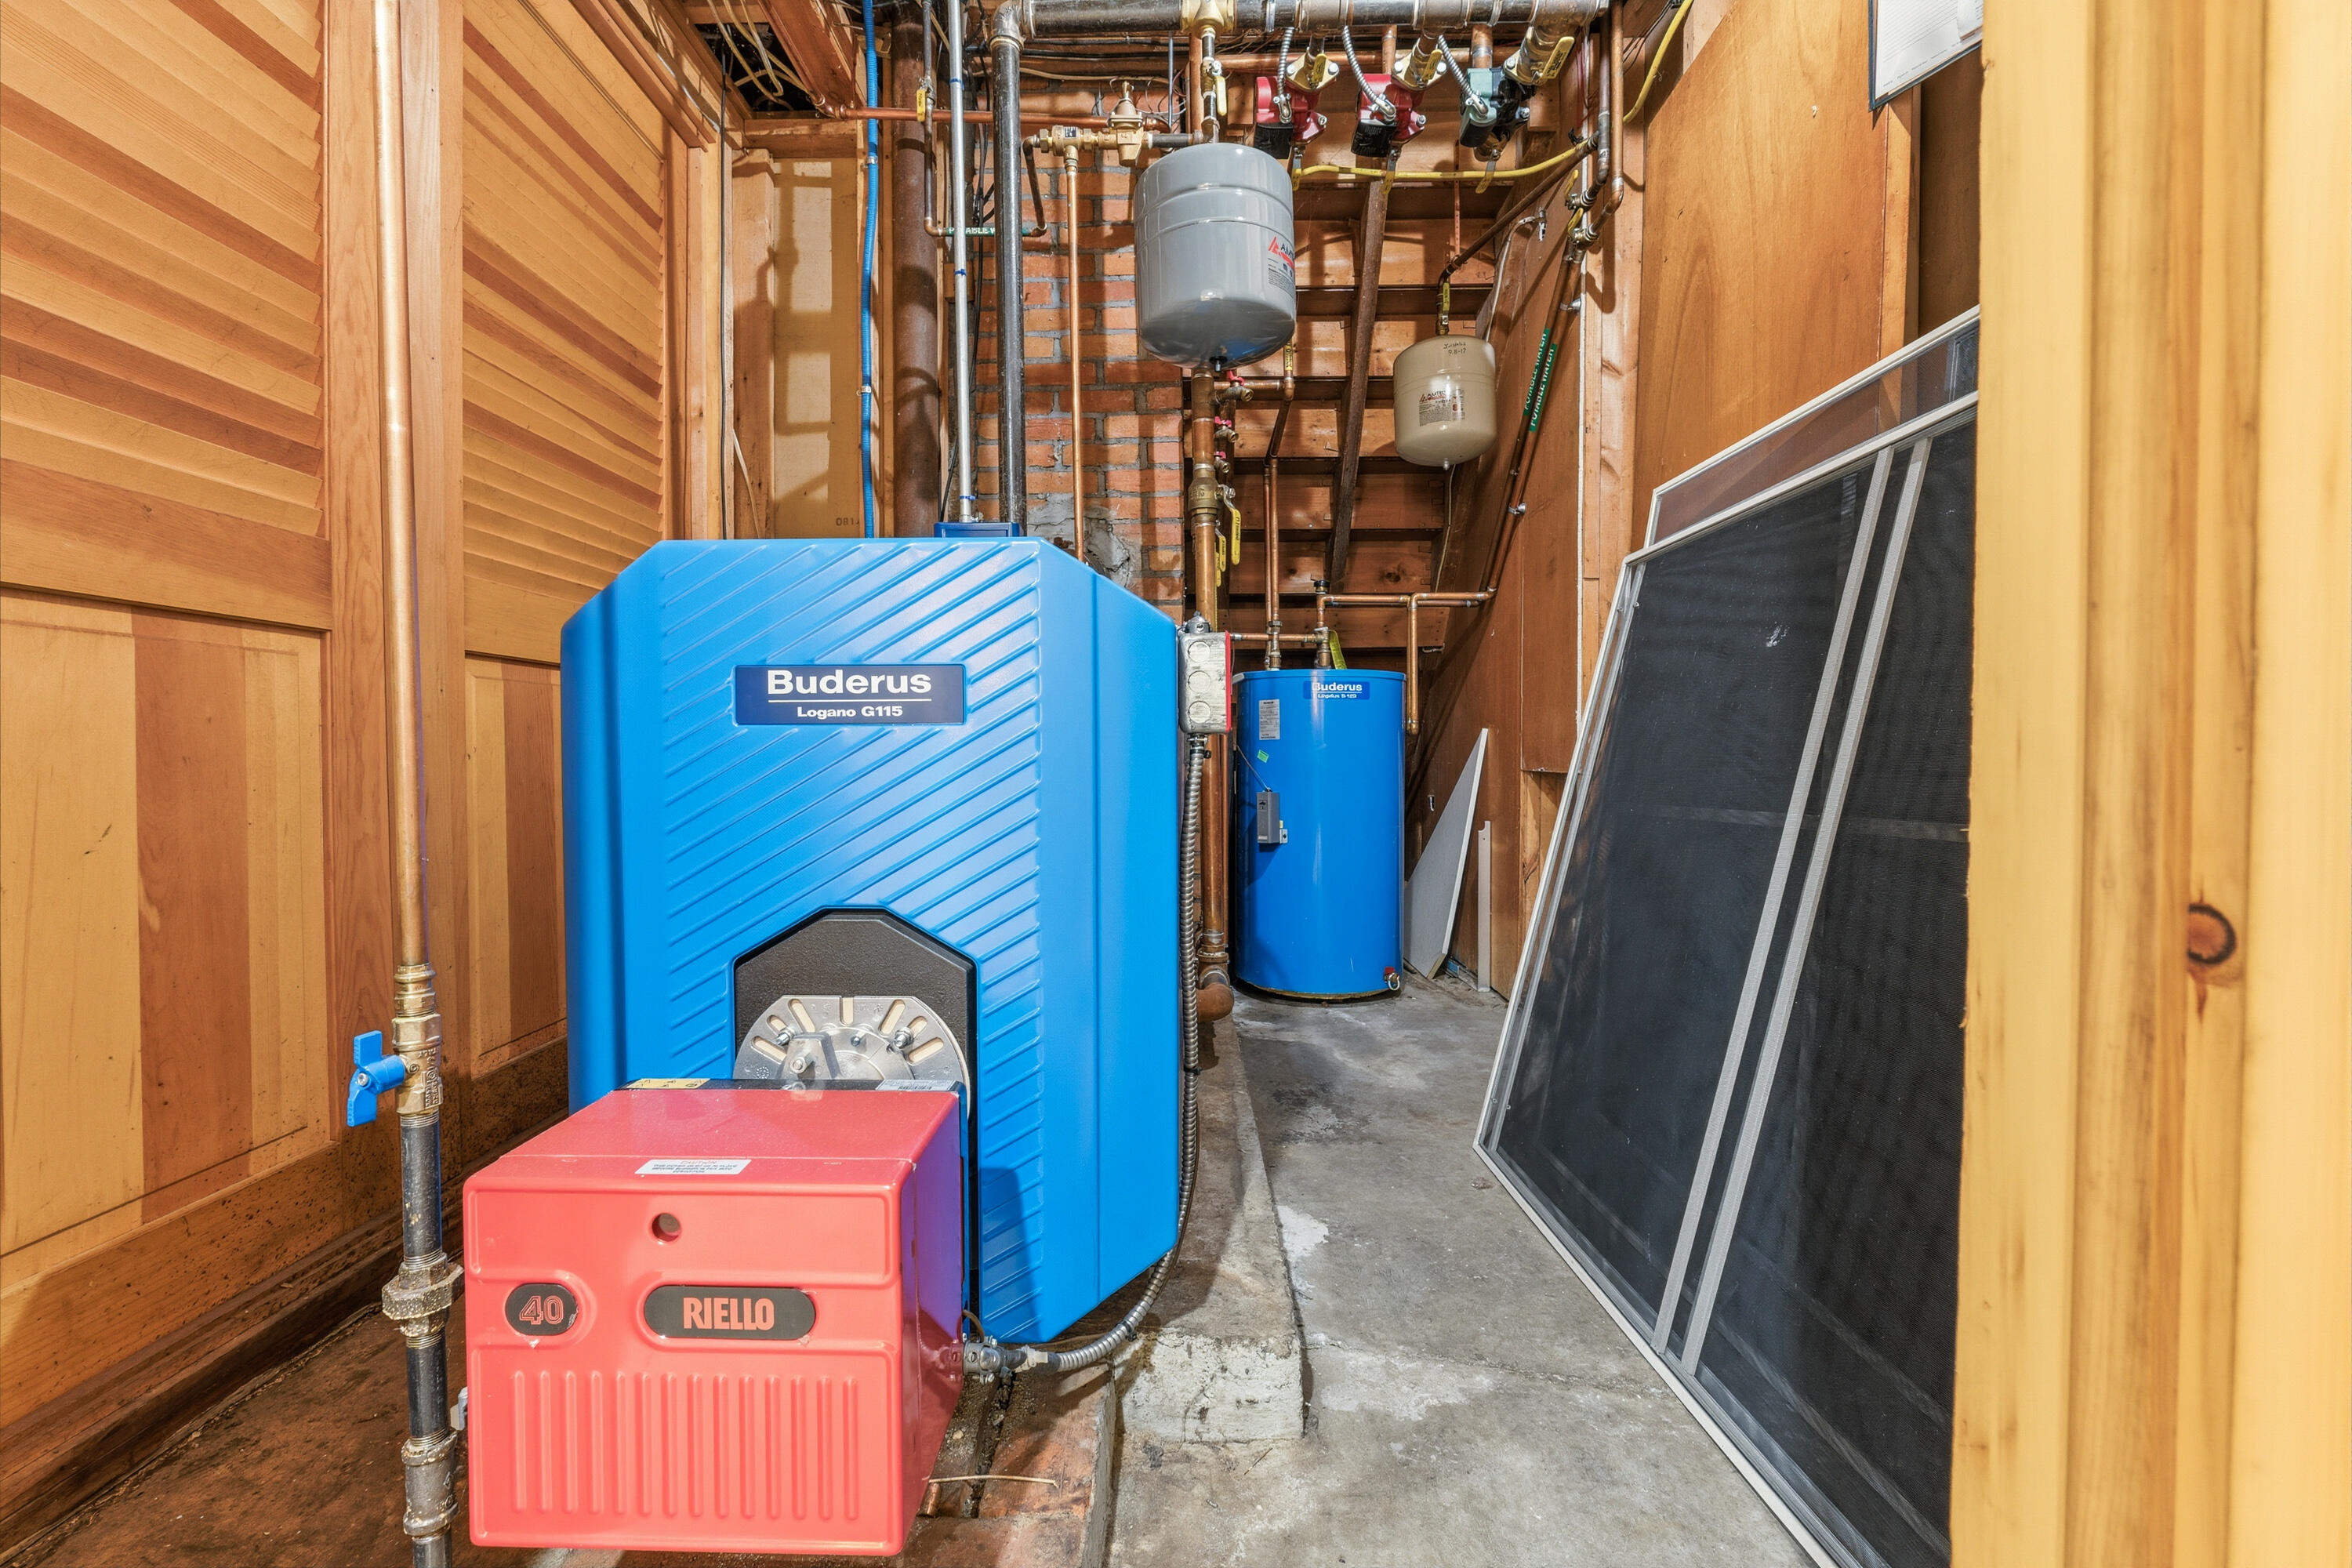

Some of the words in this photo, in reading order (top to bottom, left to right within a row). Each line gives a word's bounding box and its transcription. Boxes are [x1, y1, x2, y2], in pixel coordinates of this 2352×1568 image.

[768, 670, 931, 695] Buderus
[1312, 682, 1363, 691] Buderus
[797, 706, 856, 720] Logano
[861, 706, 903, 717] G115
[519, 1295, 564, 1325] 40
[683, 1297, 775, 1330] RIELLO
